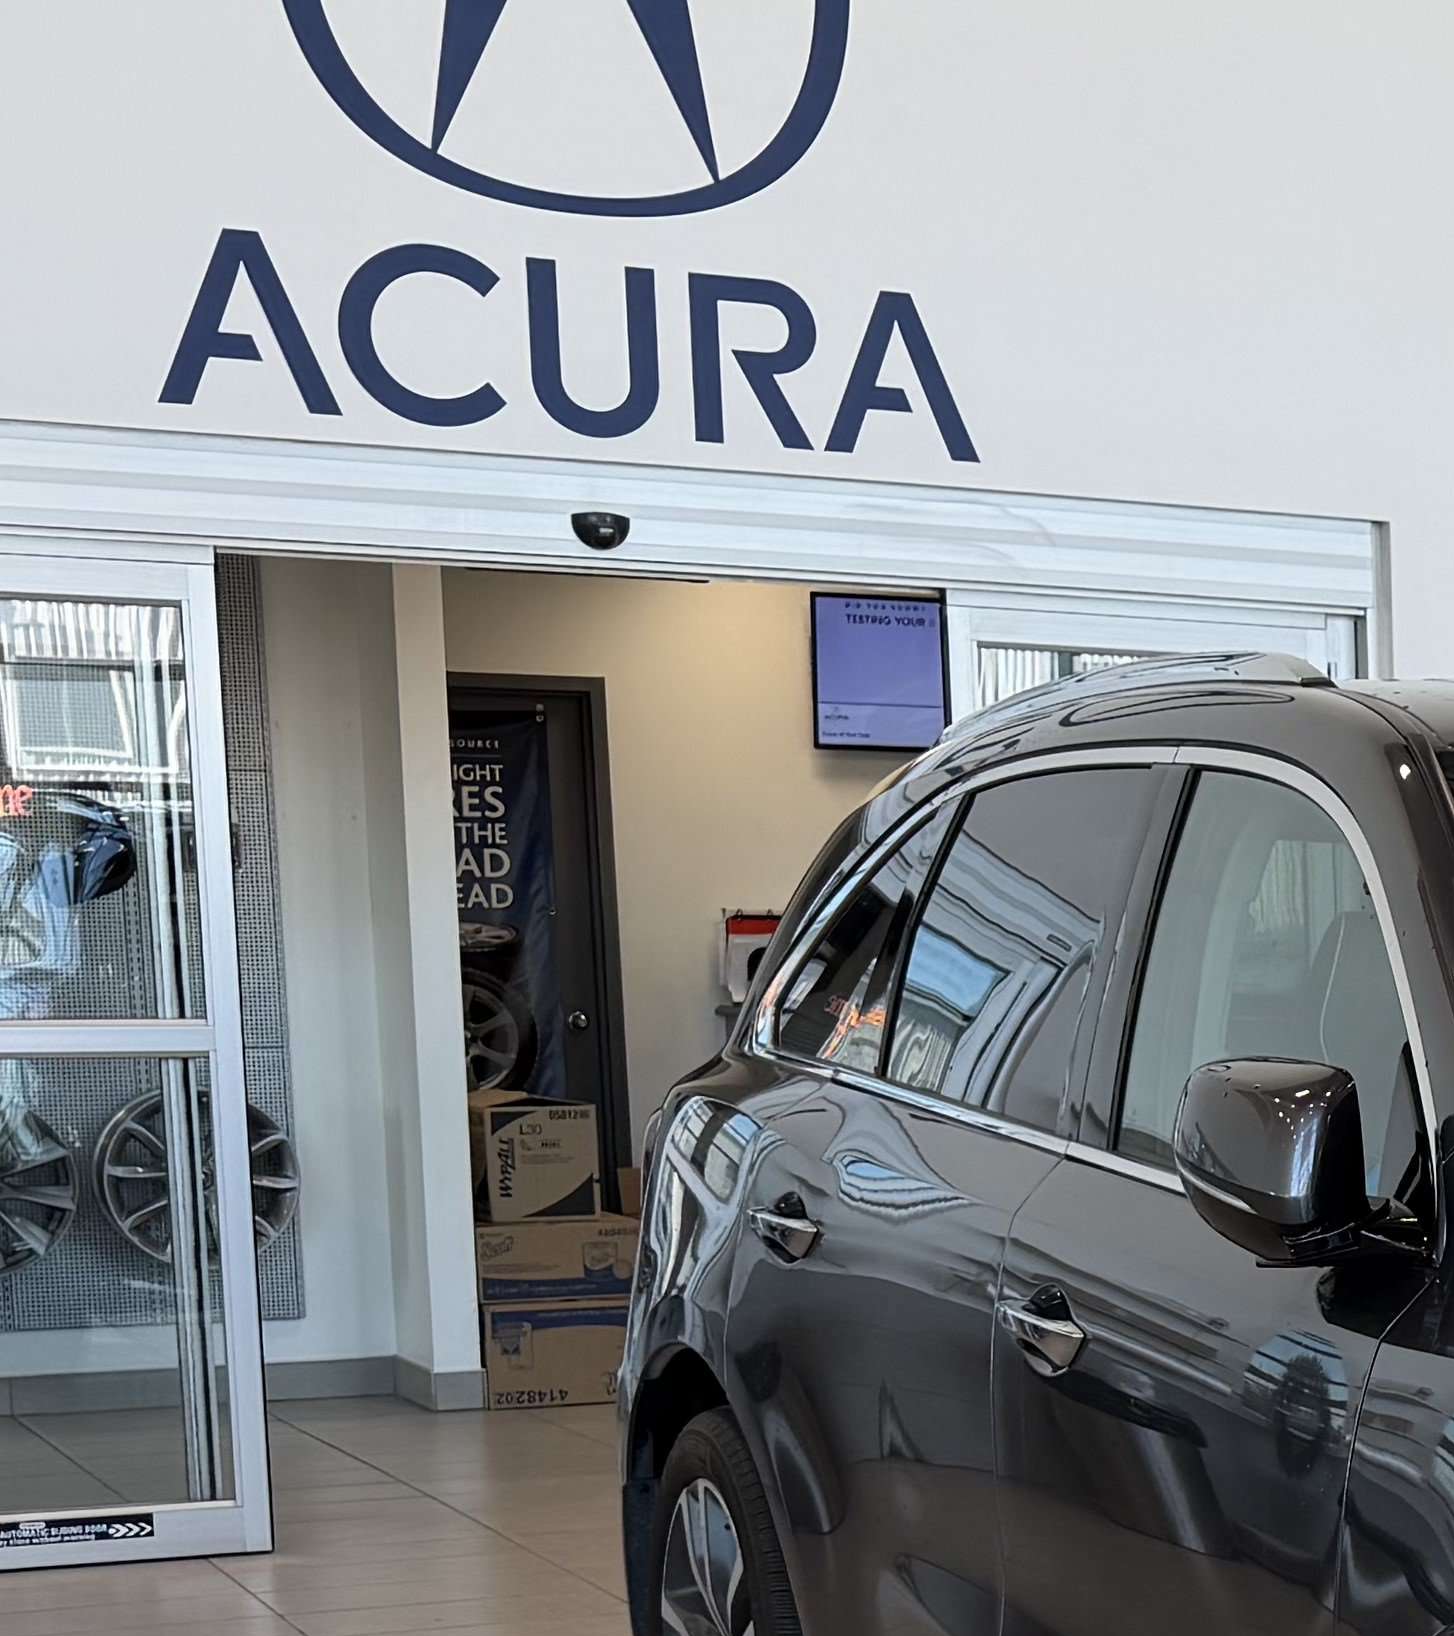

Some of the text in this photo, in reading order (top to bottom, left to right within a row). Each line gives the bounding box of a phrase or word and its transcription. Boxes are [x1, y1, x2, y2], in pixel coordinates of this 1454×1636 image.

[158, 228, 981, 464] ACURA
[452, 785, 506, 818] ES
[455, 822, 508, 845] THE
